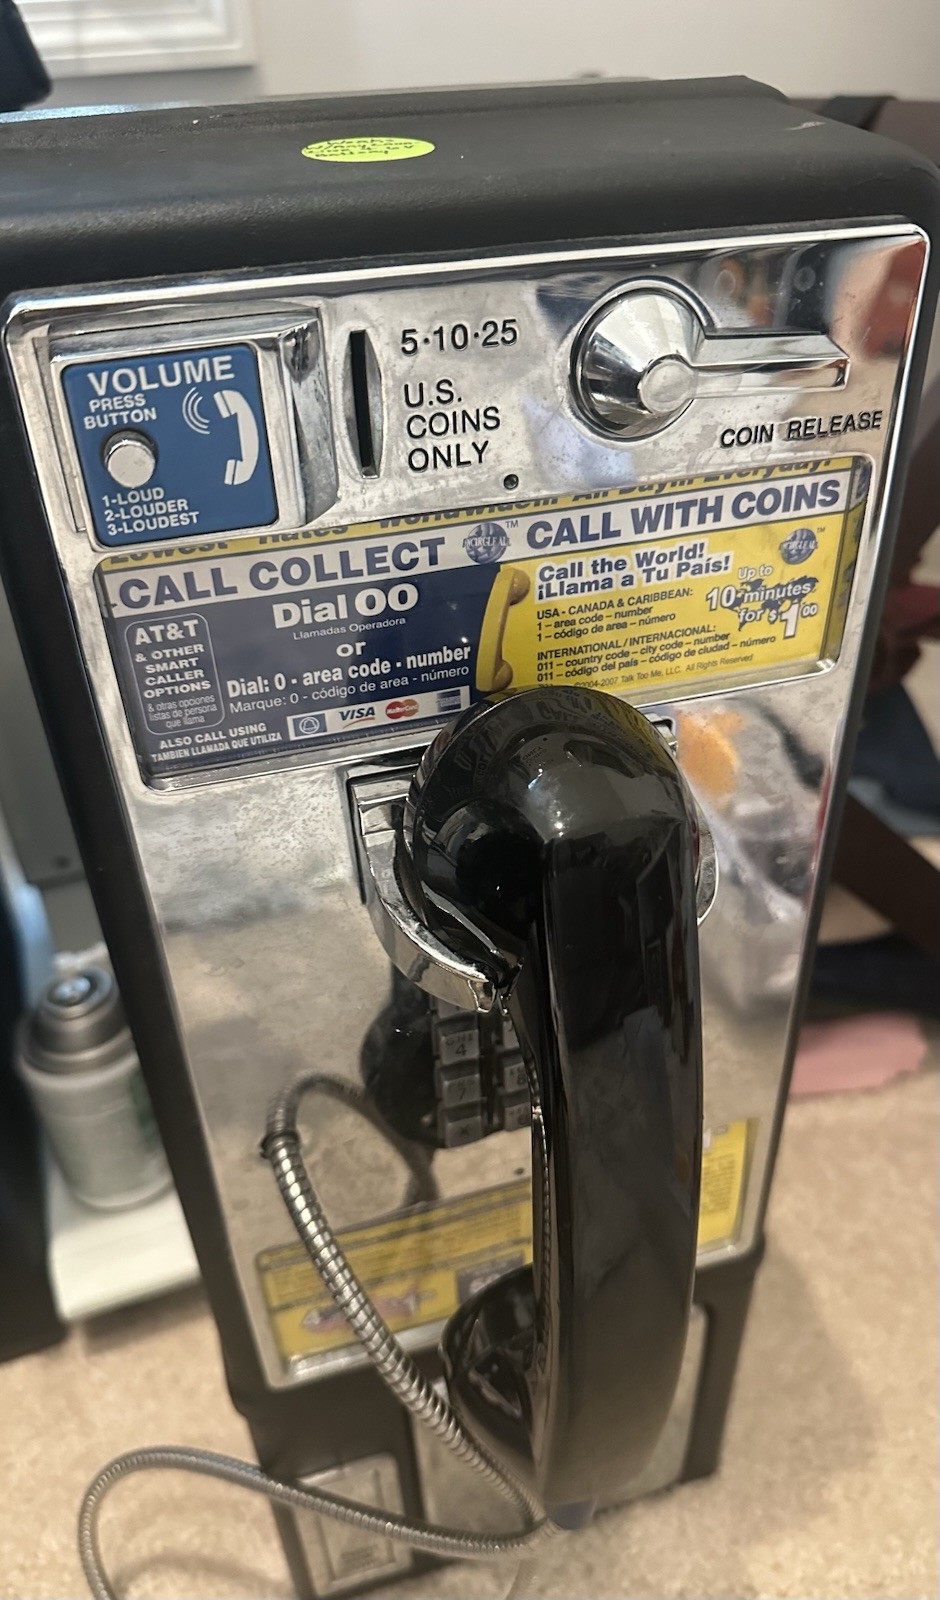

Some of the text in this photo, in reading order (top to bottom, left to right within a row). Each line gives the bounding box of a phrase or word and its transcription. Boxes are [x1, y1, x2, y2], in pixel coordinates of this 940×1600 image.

[87, 355, 235, 396] VOLUME
[89, 393, 146, 413] PRESS
[404, 379, 462, 408] U.S.
[83, 407, 158, 430] BUTTON
[406, 406, 501, 439] COINS
[720, 410, 883, 449] COIN RELEASE
[408, 440, 489, 472] ONLY
[101, 487, 165, 507] 1-LOUD
[104, 499, 189, 522] 2-LOUDER
[108, 511, 200, 536] 3-LOUDEST
[505, 520, 518, 529] TM
[527, 512, 621, 549] CALL
[631, 496, 724, 535] WITH
[731, 479, 840, 520] COINS
[119, 537, 446, 609] CALL COLLECT
[539, 542, 705, 582] Call the World!
[738, 564, 773, 581] Up to
[538, 556, 730, 600] ¡Llama a Tu País!
[537, 609, 560, 620] USA
[568, 600, 615, 616] CANADA
[617, 599, 624, 608] &
[627, 588, 694, 606] CARIBBEAN:
[706, 582, 812, 612] 10 minutes
[272, 594, 348, 630] Dial
[537, 622, 542, 631] 1
[554, 618, 576, 628] area
[579, 612, 603, 624] code
[614, 606, 653, 619] number
[739, 607, 764, 623] for
[135, 619, 199, 646] AT&T
[293, 617, 406, 640] Llamadas Operadora
[537, 633, 542, 642] 1
[554, 625, 589, 640] código
[591, 624, 604, 634] de
[606, 621, 628, 631] area
[638, 612, 676, 626] número
[135, 643, 205, 663] & OTHER
[336, 641, 367, 657] or
[537, 661, 553, 671] 011
[565, 650, 603, 667] country
[605, 647, 630, 660] code
[640, 644, 658, 657] city
[659, 640, 683, 653] code
[694, 633, 730, 646] number
[537, 671, 553, 682] 011
[565, 664, 599, 678] código
[601, 661, 616, 672] del
[618, 658, 639, 672] país
[649, 649, 682, 664] código
[684, 648, 696, 658] de
[698, 641, 730, 655] ciudad
[740, 636, 776, 648] número
[145, 657, 199, 674] SMART
[145, 669, 205, 686] CALLER
[227, 676, 270, 698] Dial:
[274, 673, 286, 690] 0
[303, 667, 343, 686] area
[348, 658, 391, 678] code
[406, 646, 471, 669] number
[621, 673, 635, 683] Talk
[637, 670, 650, 681] Too
[696, 658, 718, 671] Rights
[143, 680, 211, 699] OPTIONS
[229, 696, 287, 715] Marque:
[289, 693, 299, 704] 0
[312, 685, 356, 700] código
[360, 682, 376, 693] de
[380, 676, 409, 689] area
[421, 666, 469, 682] número
[339, 706, 376, 721] VISA
[151, 748, 190, 762] TAMBIEN
[191, 741, 231, 756] LLAMADA
[232, 738, 249, 749] QUE
[250, 732, 282, 747] UTILIZA
[160, 723, 267, 750] ALSO CALL USING
[456, 1043, 467, 1056] 4
